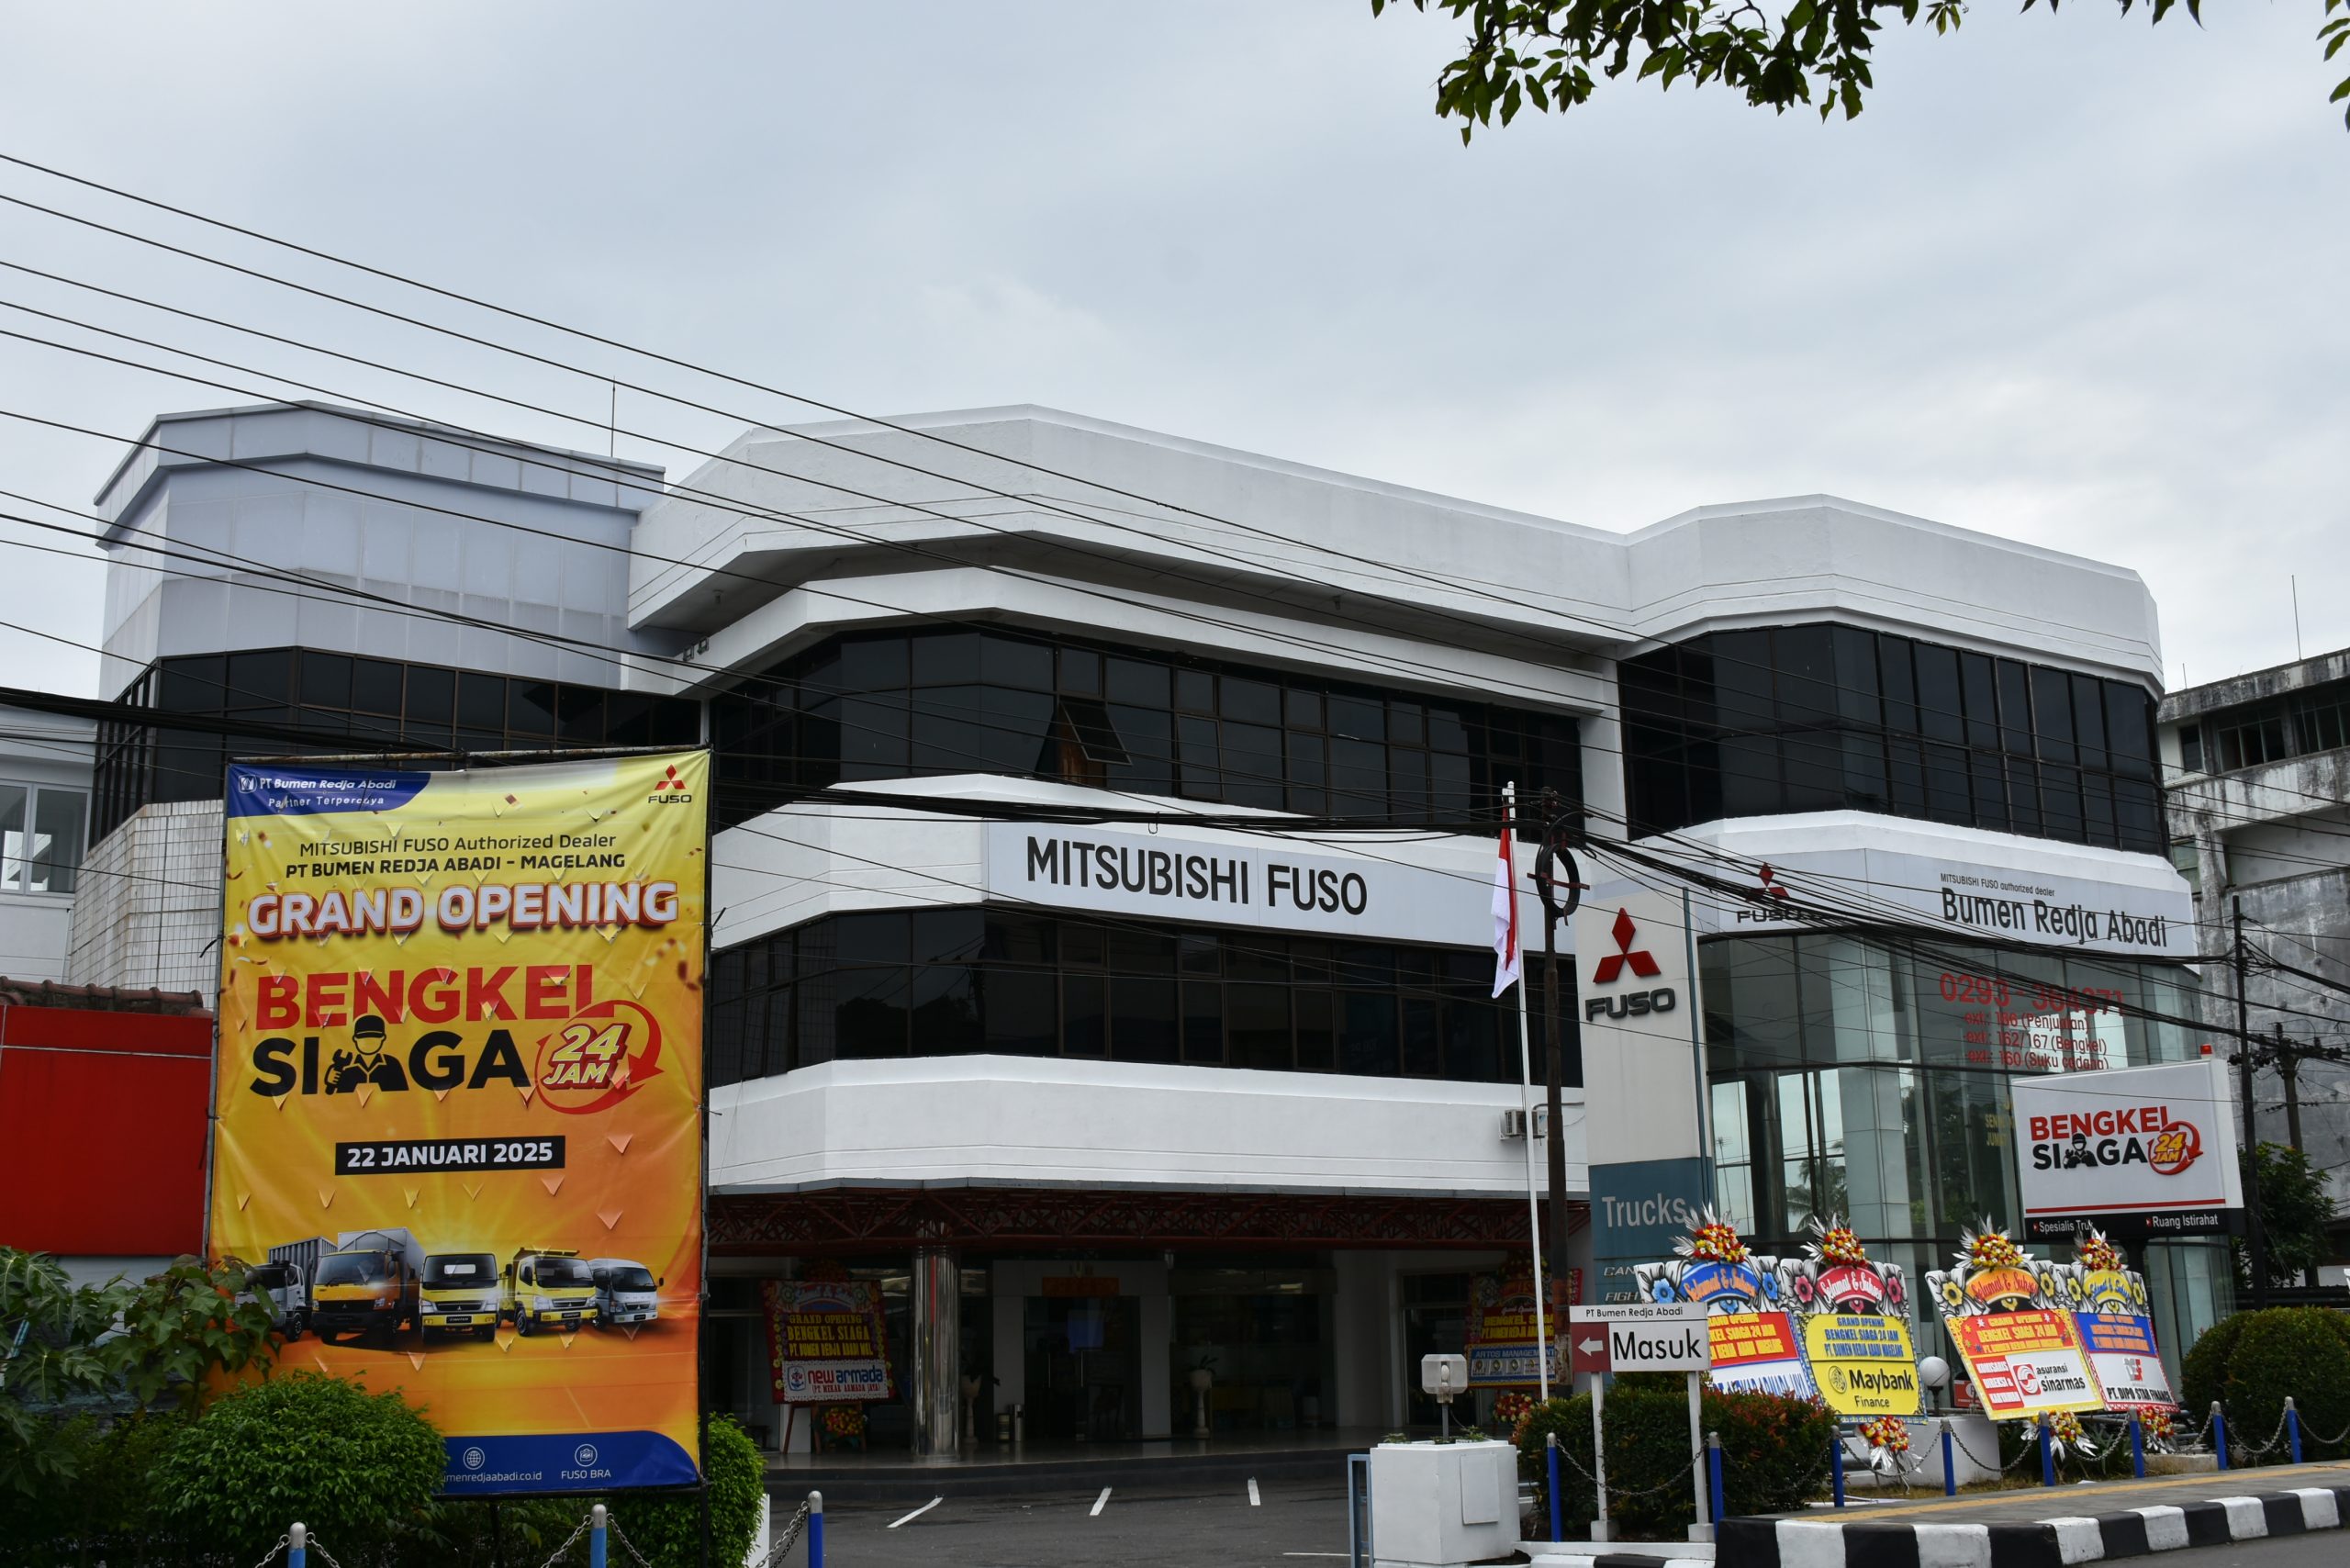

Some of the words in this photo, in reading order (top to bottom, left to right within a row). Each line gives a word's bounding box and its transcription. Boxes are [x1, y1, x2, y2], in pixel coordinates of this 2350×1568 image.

[260, 778, 271, 789] PT
[274, 778, 316, 789] Bumen
[320, 780, 355, 790] Redja
[359, 779, 396, 789] Abadi
[648, 794, 692, 804] FUSO
[300, 841, 397, 857] MITSUBISHI
[404, 837, 449, 852] FUSO
[454, 834, 553, 850] Authorized
[560, 834, 616, 848] Dealer
[285, 864, 308, 879] PT
[312, 861, 375, 877] BUMEN
[380, 858, 438, 874] REDJA
[443, 857, 501, 871] ABADI
[520, 854, 626, 869] MAGELANG
[1027, 836, 1249, 904] MITSUBISHI
[1268, 864, 1368, 915] FUSO
[1941, 873, 1979, 887] MITSUBISHI
[1981, 879, 1998, 889] FUSO
[2000, 882, 2033, 894] authorized
[2035, 886, 2055, 897] dealer
[246, 886, 425, 937] GRAND
[438, 880, 678, 930] OPENING
[1942, 887, 2026, 930] Bumen
[2033, 900, 2098, 945] Redja
[2107, 910, 2167, 947] Abadi
[1940, 972, 2011, 1007] 0293
[1585, 988, 1675, 1022] FUSO
[550, 1024, 630, 1063] 24
[543, 1063, 610, 1084] JAM
[2155, 1133, 2187, 1152] 24
[347, 1148, 375, 1168] 22
[381, 1145, 487, 1166] JANUARI
[493, 1142, 553, 1163] 2025
[2153, 1151, 2181, 1163] JAM
[1602, 1193, 1687, 1227] Trucks
[2039, 1221, 2075, 1234] Spesialis
[2153, 1215, 2180, 1229] Ruang
[2183, 1214, 2218, 1226] Istirahat
[1604, 1267, 1636, 1277] CAN
[1606, 1292, 1639, 1301] FIGH
[789, 1315, 822, 1324] GRAND
[1585, 1309, 1595, 1317] PT
[1596, 1308, 1627, 1317] Bumen
[1629, 1308, 1653, 1319] Redja
[1656, 1306, 1683, 1316] Abadi
[787, 1326, 835, 1341] BENGKEL
[837, 1325, 870, 1340] SIAGA
[1613, 1328, 1702, 1361] Masuk
[808, 1371, 834, 1383] new
[836, 1365, 883, 1383] armada
[2036, 1363, 2068, 1374] asuransi
[1849, 1369, 1914, 1394] Maybank
[2042, 1376, 2086, 1392] sinarmas
[1854, 1395, 1890, 1407] Finance
[2120, 1387, 2135, 1400] DIPO
[561, 1470, 588, 1480] FUSO
[590, 1469, 611, 1479] BRA
